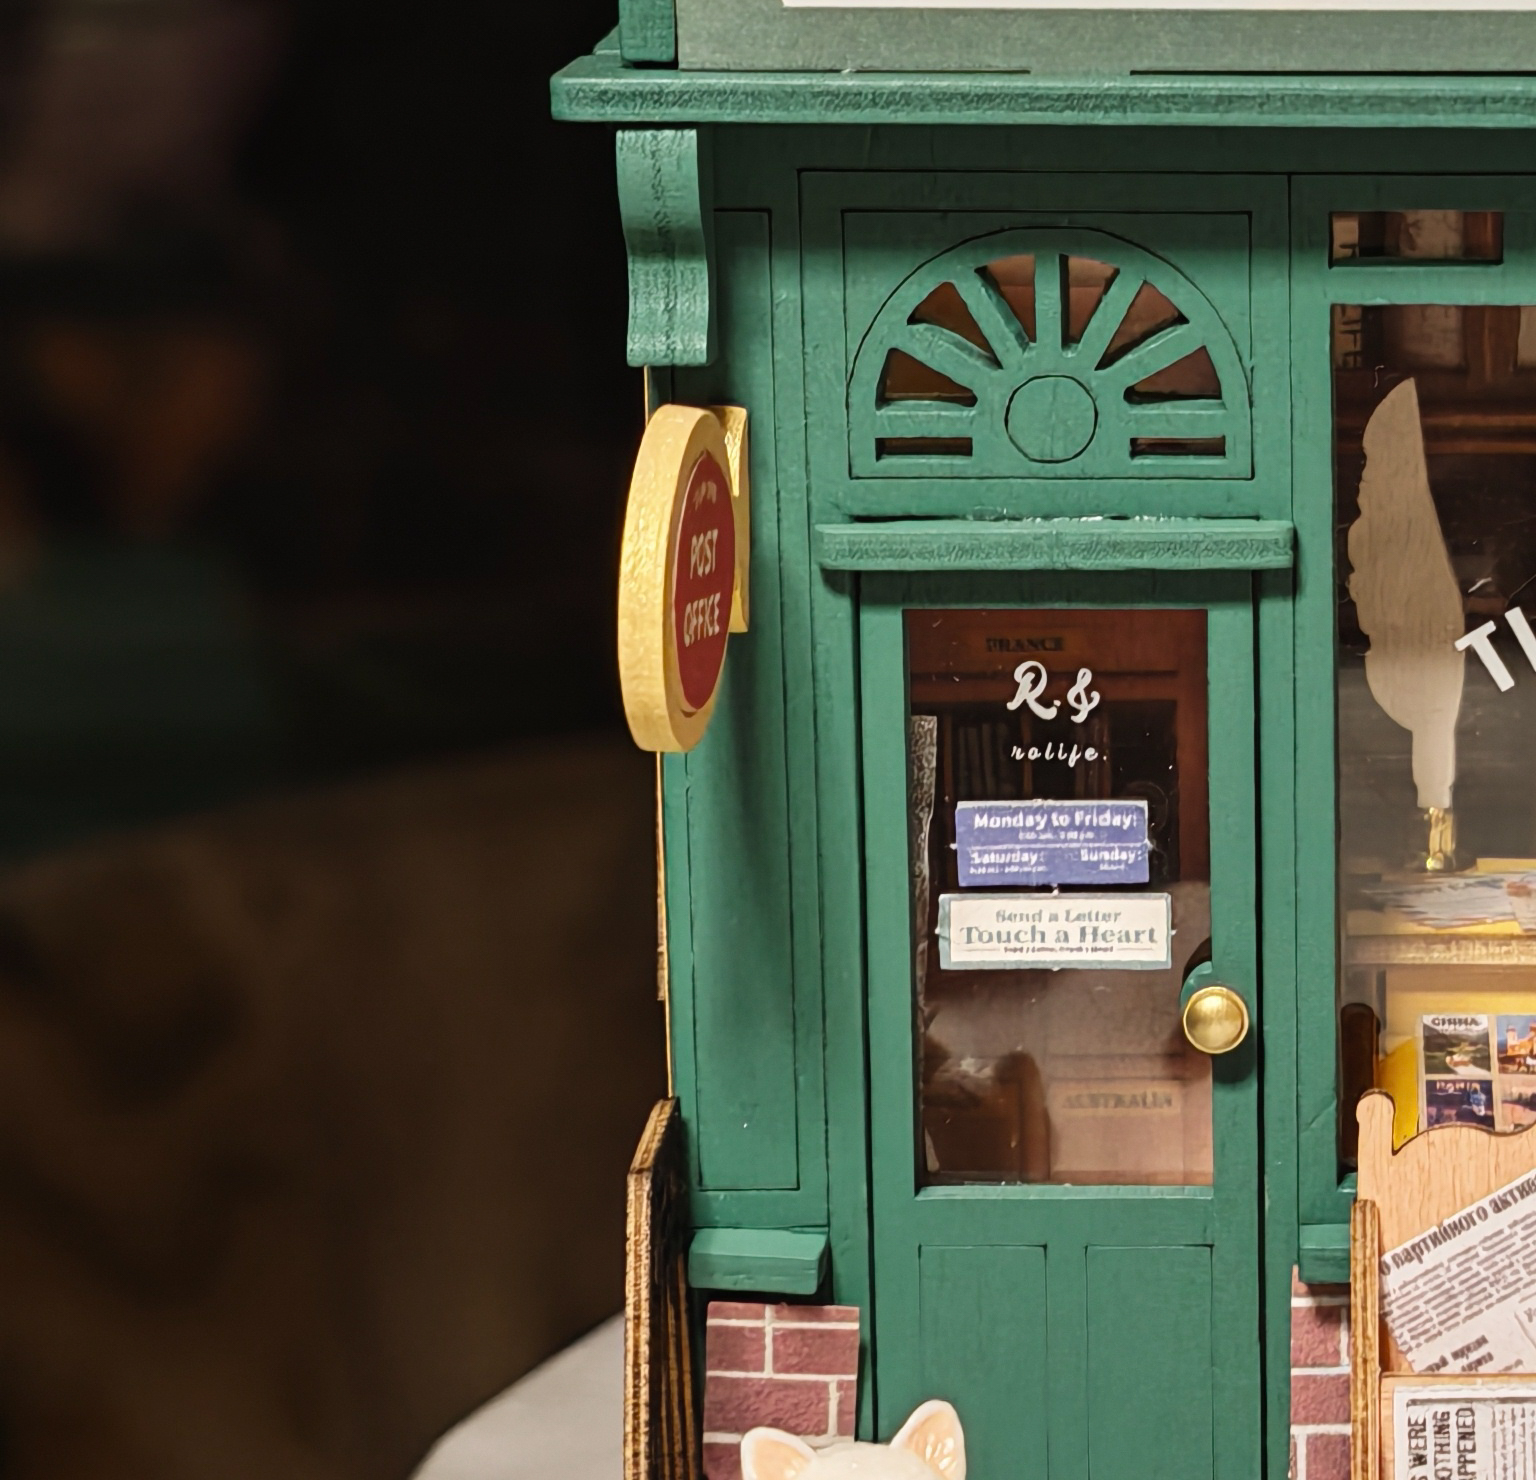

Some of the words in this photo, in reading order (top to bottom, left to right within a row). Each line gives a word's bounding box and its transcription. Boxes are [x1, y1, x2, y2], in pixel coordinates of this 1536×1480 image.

[690, 528, 719, 580] POST
[683, 592, 722, 648] OFFICE
[973, 809, 1048, 831] Monday
[1052, 811, 1071, 828] to
[995, 908, 1043, 923] Send
[1064, 908, 1122, 924] Letter
[959, 924, 1047, 945] Touch
[1055, 928, 1070, 944] a
[1078, 925, 1159, 945] Heart
